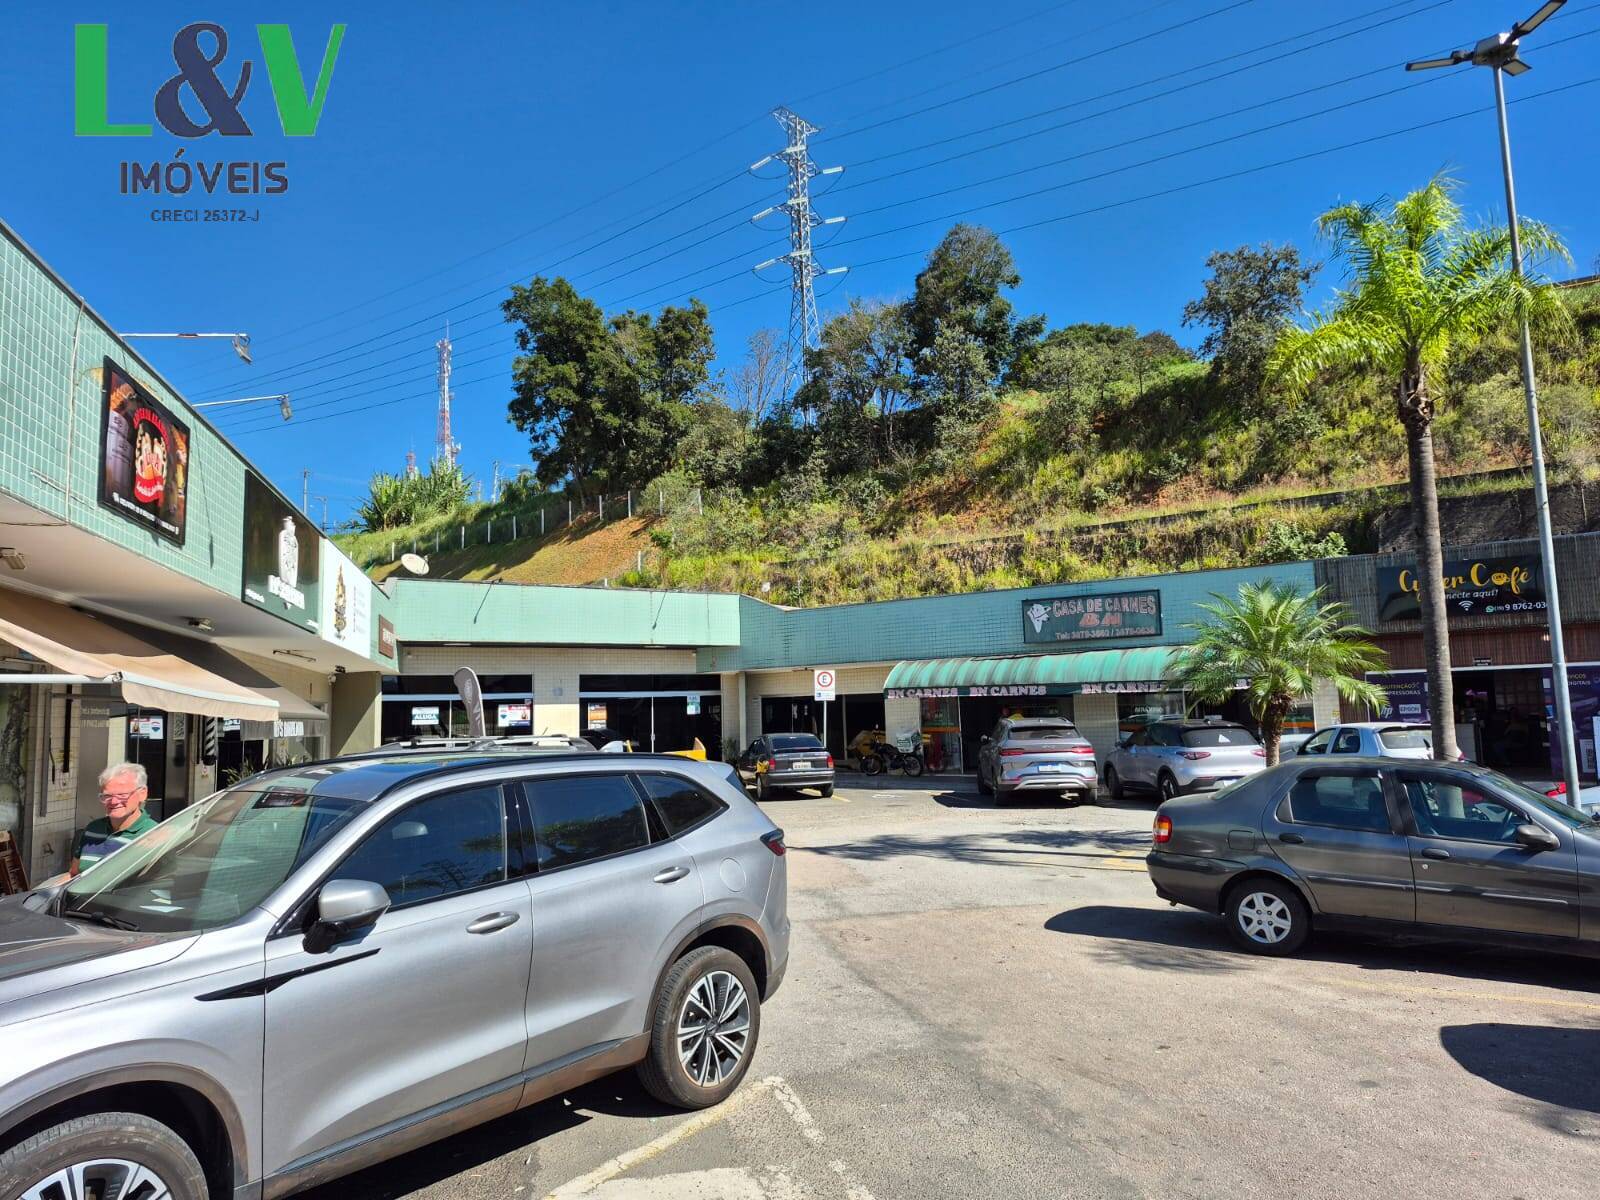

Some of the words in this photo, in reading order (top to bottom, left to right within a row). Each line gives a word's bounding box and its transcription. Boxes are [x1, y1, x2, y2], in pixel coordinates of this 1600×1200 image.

[1052, 600, 1085, 618] CASA
[1086, 598, 1103, 613] DE
[1104, 596, 1157, 615] CARNES
[1512, 601, 1547, 611] 8762-03
[906, 687, 959, 697] CARNES
[990, 685, 1047, 696] CARNES
